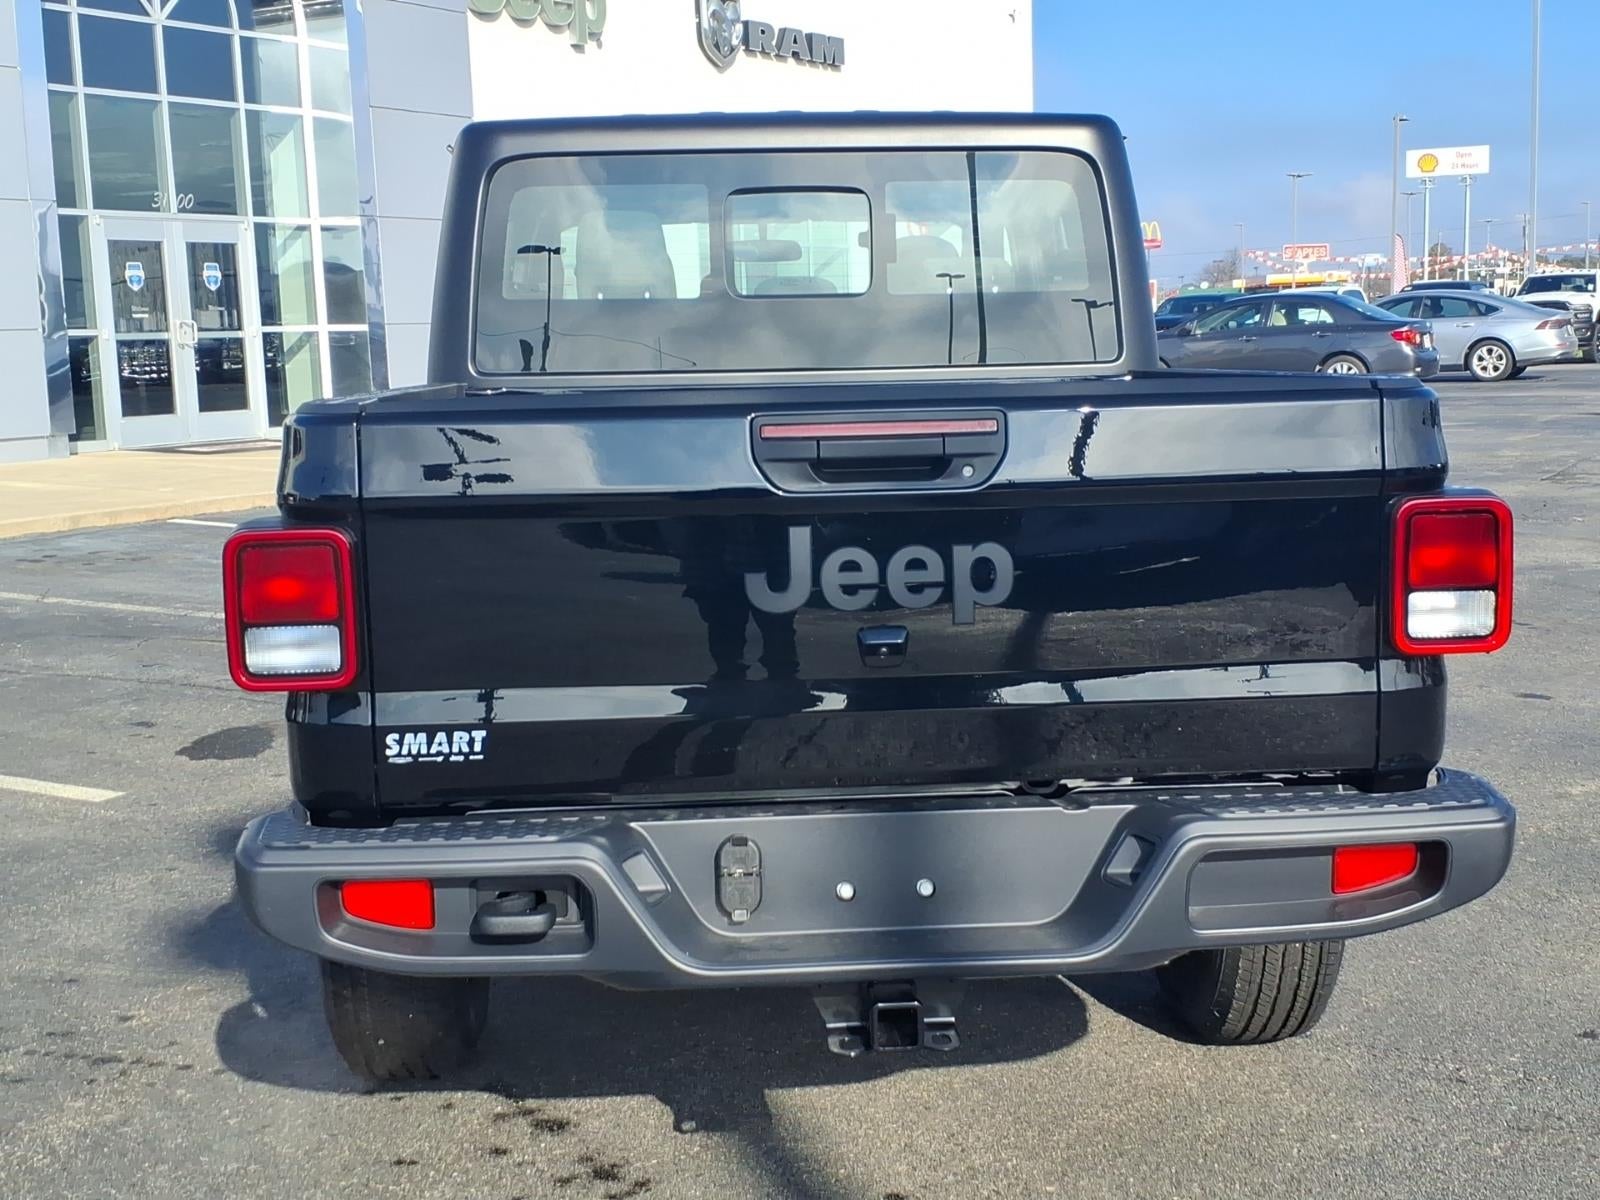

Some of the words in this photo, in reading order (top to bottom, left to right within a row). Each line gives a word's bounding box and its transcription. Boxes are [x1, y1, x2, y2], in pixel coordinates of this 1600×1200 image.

[742, 20, 845, 66] RAM
[744, 525, 1014, 624] Jeep
[385, 730, 487, 756] SMART
